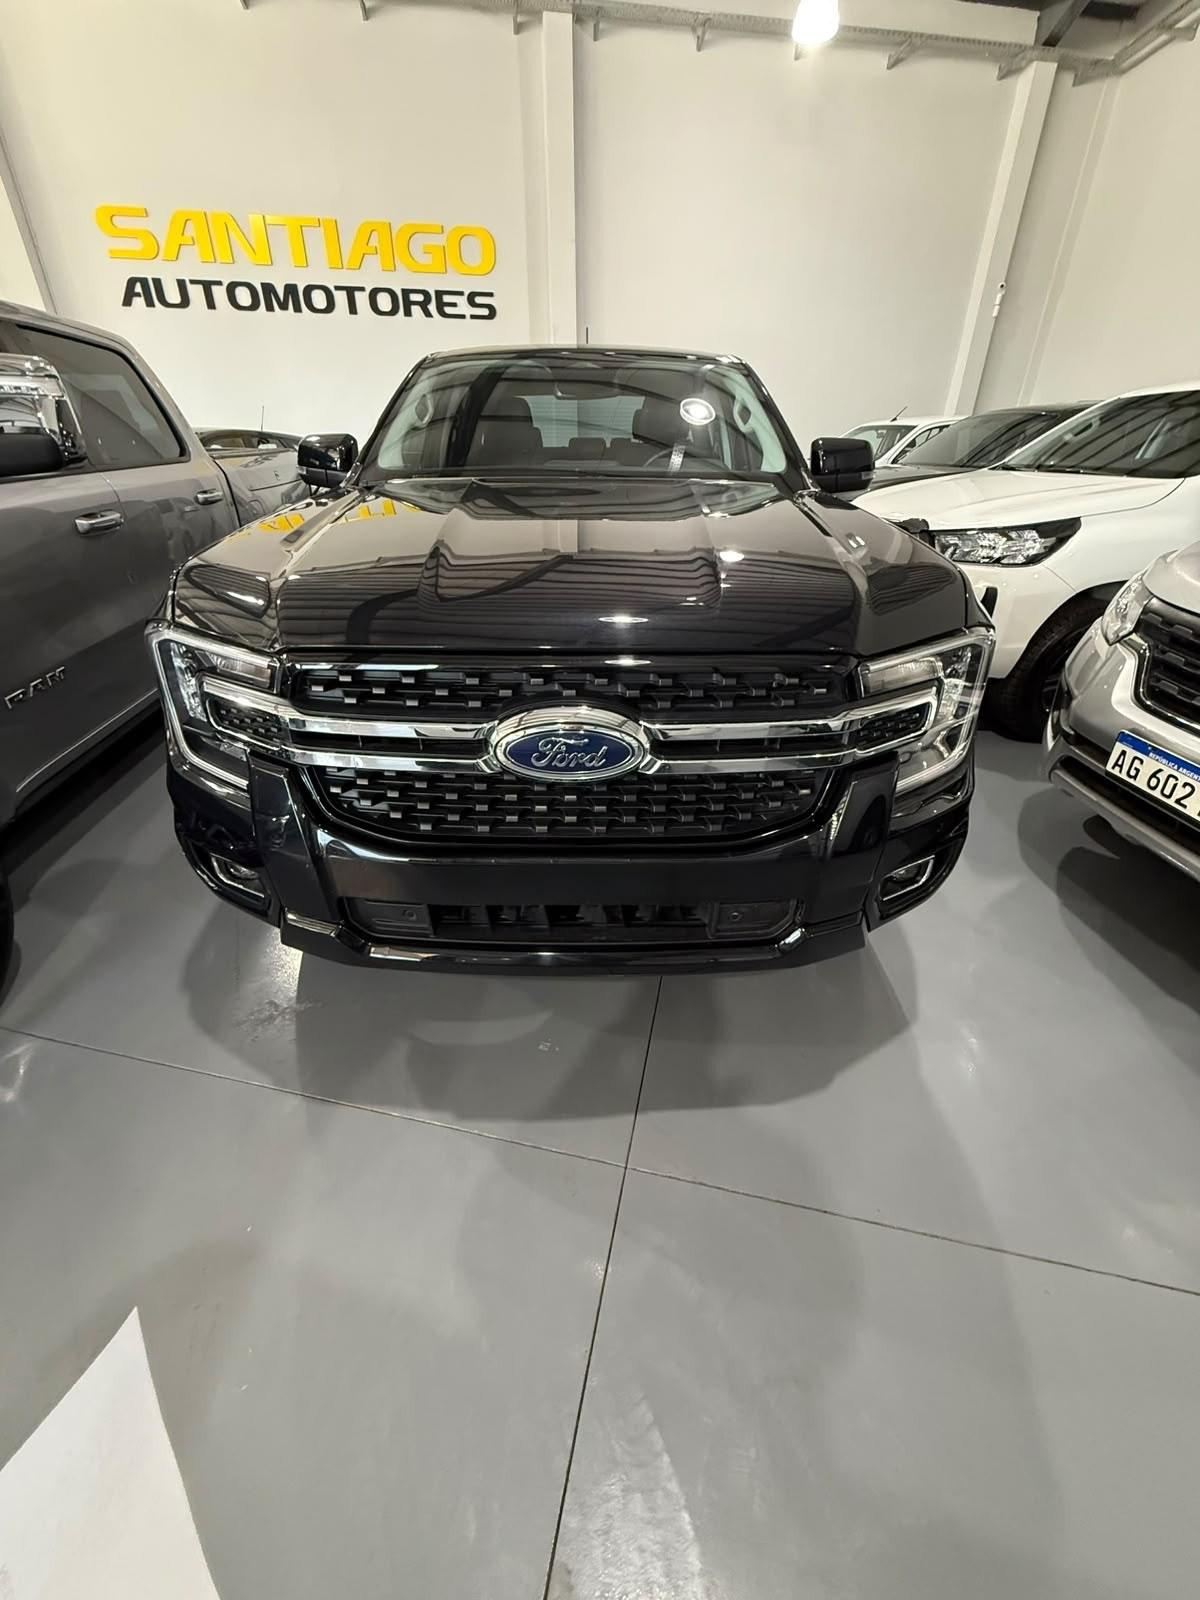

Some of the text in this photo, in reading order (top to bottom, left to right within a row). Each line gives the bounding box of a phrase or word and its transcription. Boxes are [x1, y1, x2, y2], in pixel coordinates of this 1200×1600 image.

[95, 205, 496, 275] SANTIAGO
[121, 276, 497, 320] AUTOMOTORES
[531, 737, 608, 768] Ford
[1111, 749, 1195, 809] AG 602
